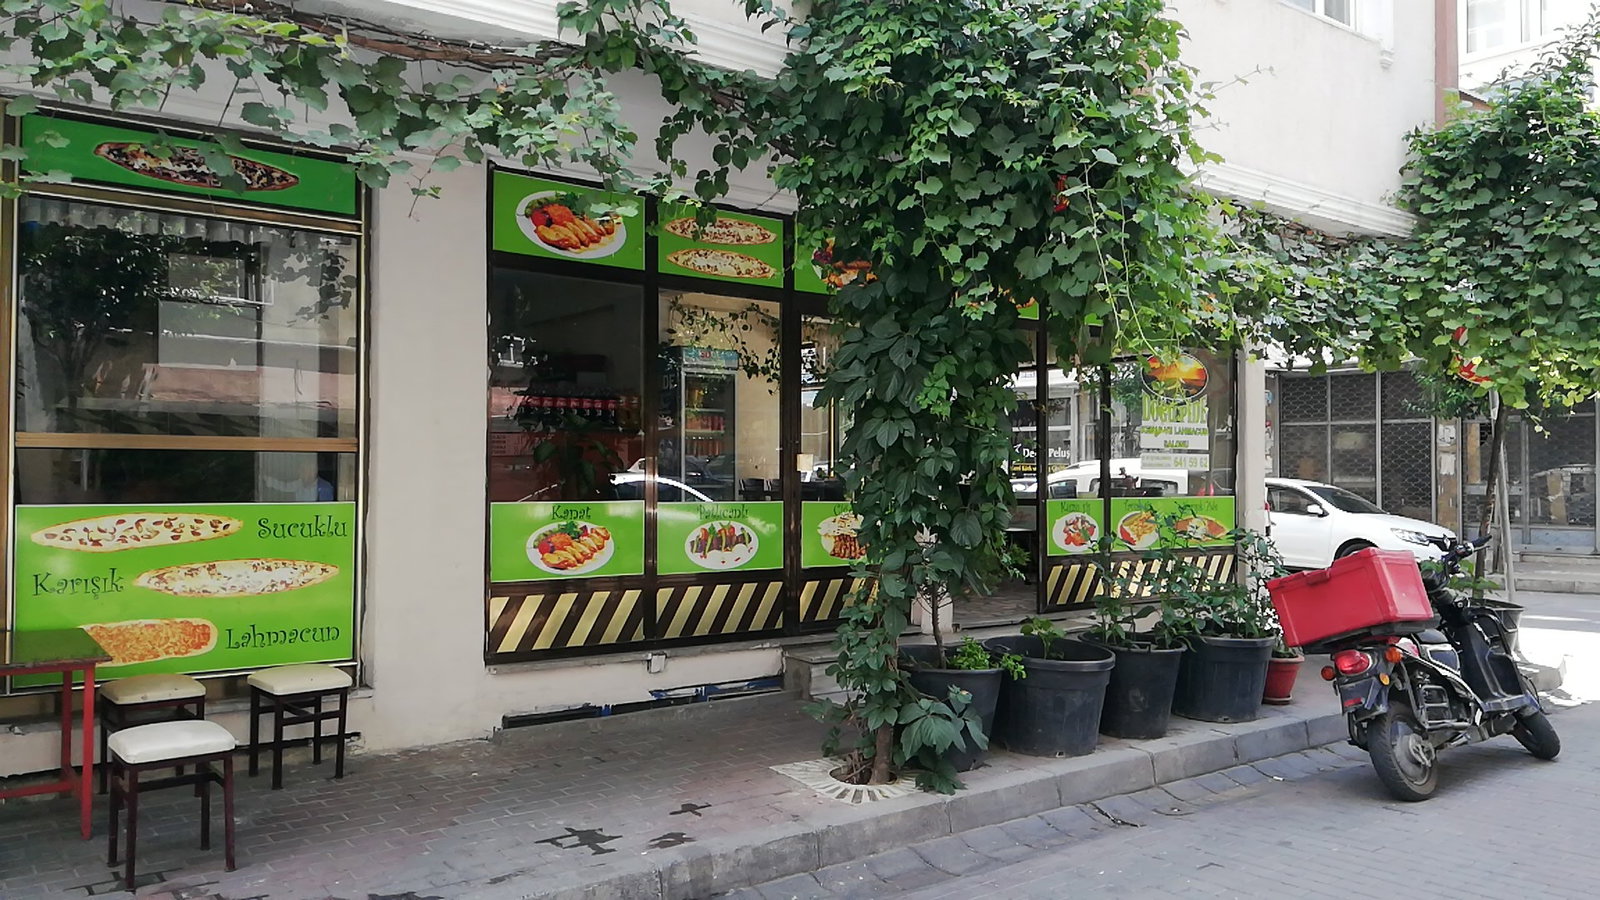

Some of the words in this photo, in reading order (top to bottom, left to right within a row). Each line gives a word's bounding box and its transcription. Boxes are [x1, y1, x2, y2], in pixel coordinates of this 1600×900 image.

[552, 504, 592, 520] Kanat
[257, 514, 348, 539] Sucuklu
[33, 568, 125, 600] Karışık
[225, 624, 341, 650] Lahmacun
